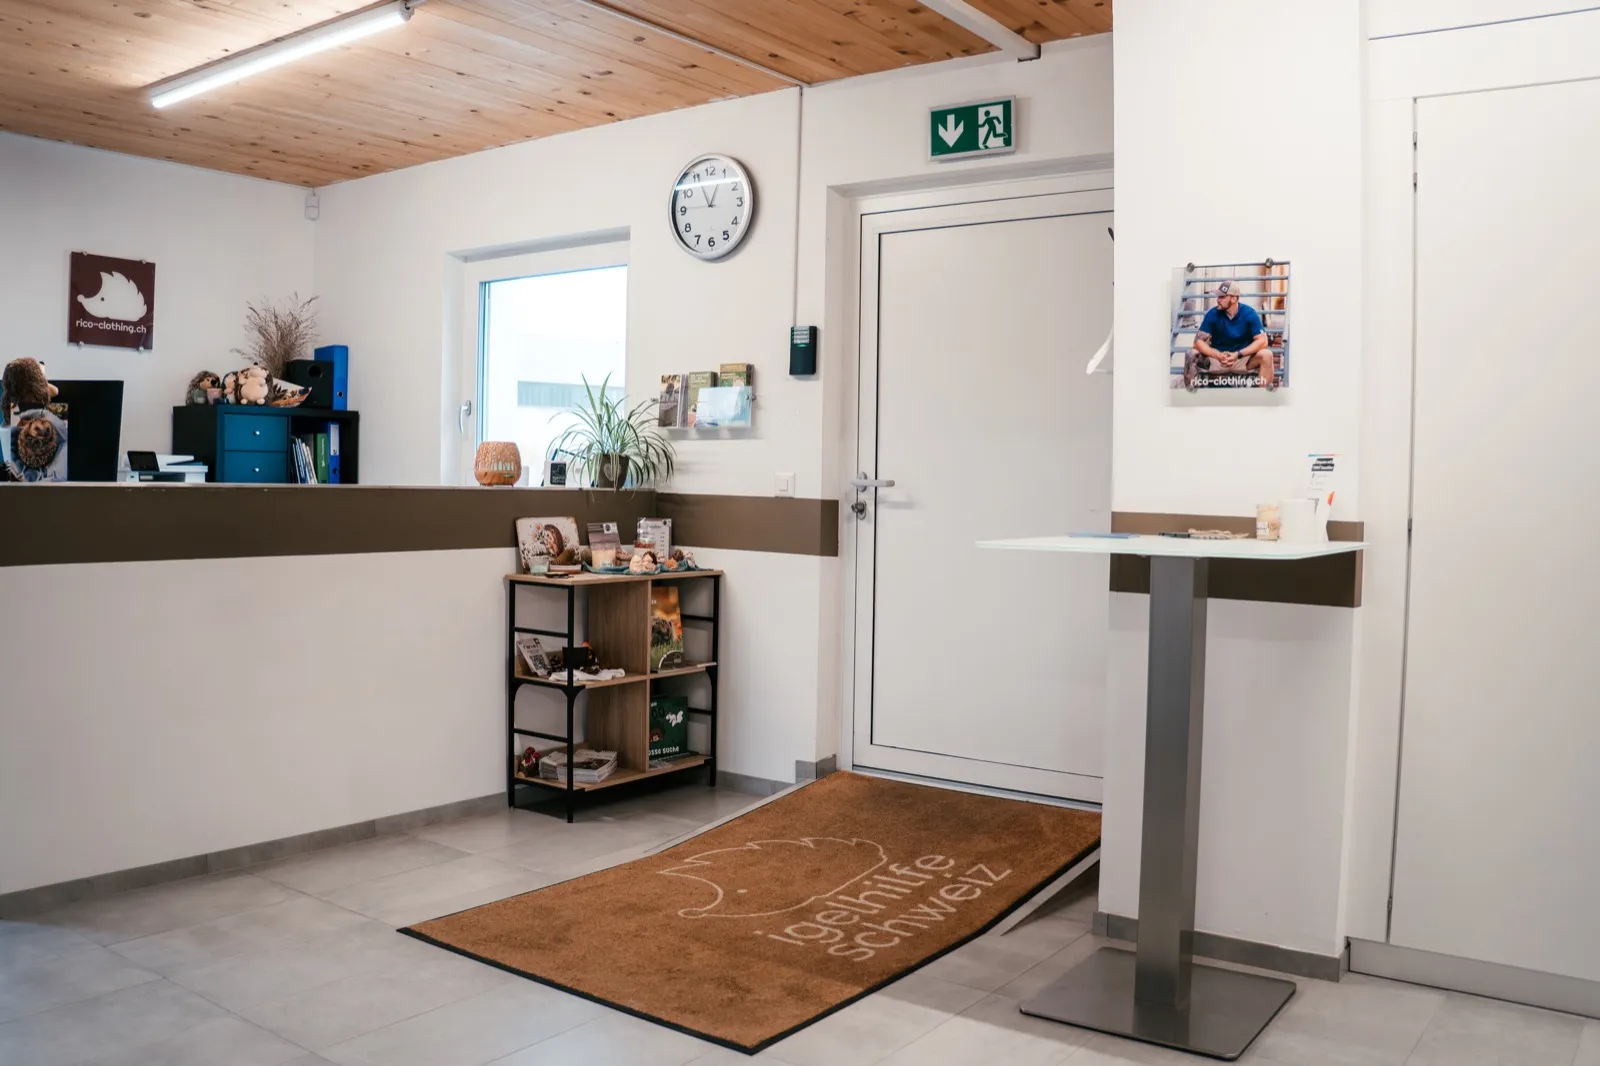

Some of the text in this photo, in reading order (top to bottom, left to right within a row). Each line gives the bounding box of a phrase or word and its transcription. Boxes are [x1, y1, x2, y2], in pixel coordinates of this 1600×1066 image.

[705, 166, 716, 177] 12
[722, 168, 727, 178] 1
[731, 182, 739, 191] 2
[683, 188, 693, 199] 10
[736, 197, 744, 207] 3
[680, 206, 687, 216] 9
[731, 216, 738, 226] 4
[684, 223, 692, 233] 8
[694, 234, 701, 245] 7
[722, 230, 730, 241] 5
[708, 237, 715, 247] 6
[75, 318, 147, 334] rico-clothing.ch
[1190, 376, 1267, 388] rico-clothing.ch
[828, 863, 1012, 962] schweiz
